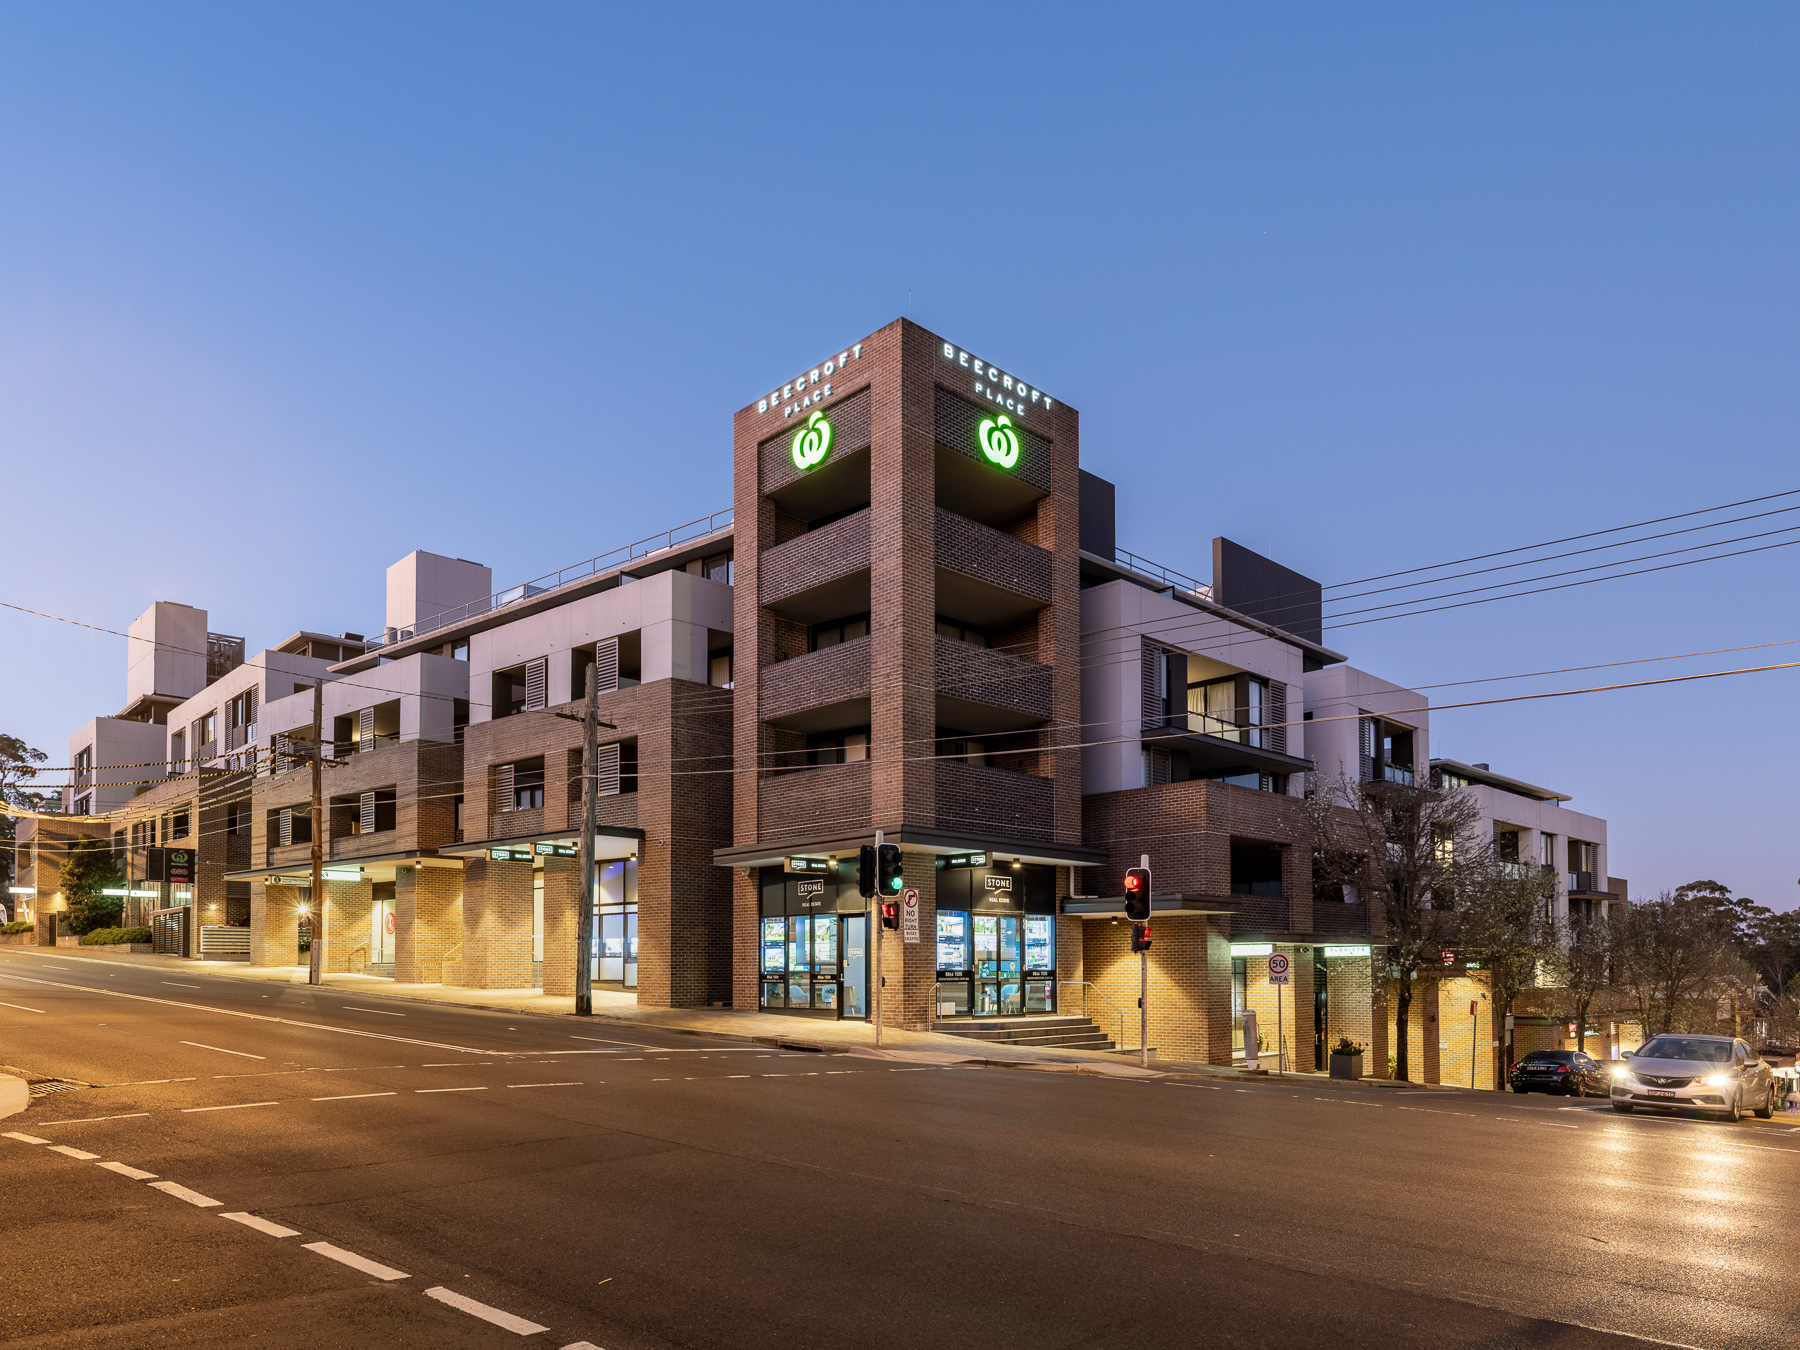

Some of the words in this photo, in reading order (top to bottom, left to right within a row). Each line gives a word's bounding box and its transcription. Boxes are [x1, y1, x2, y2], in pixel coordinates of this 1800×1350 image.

[758, 344, 863, 414] BEECROFT
[943, 343, 1053, 411] BEECROFT
[784, 383, 832, 418] PLACE
[975, 382, 1025, 416] PLACE
[800, 882, 822, 892] STONE
[987, 878, 1010, 888] STONE
[905, 909, 916, 917] NO
[1272, 960, 1286, 968] 50
